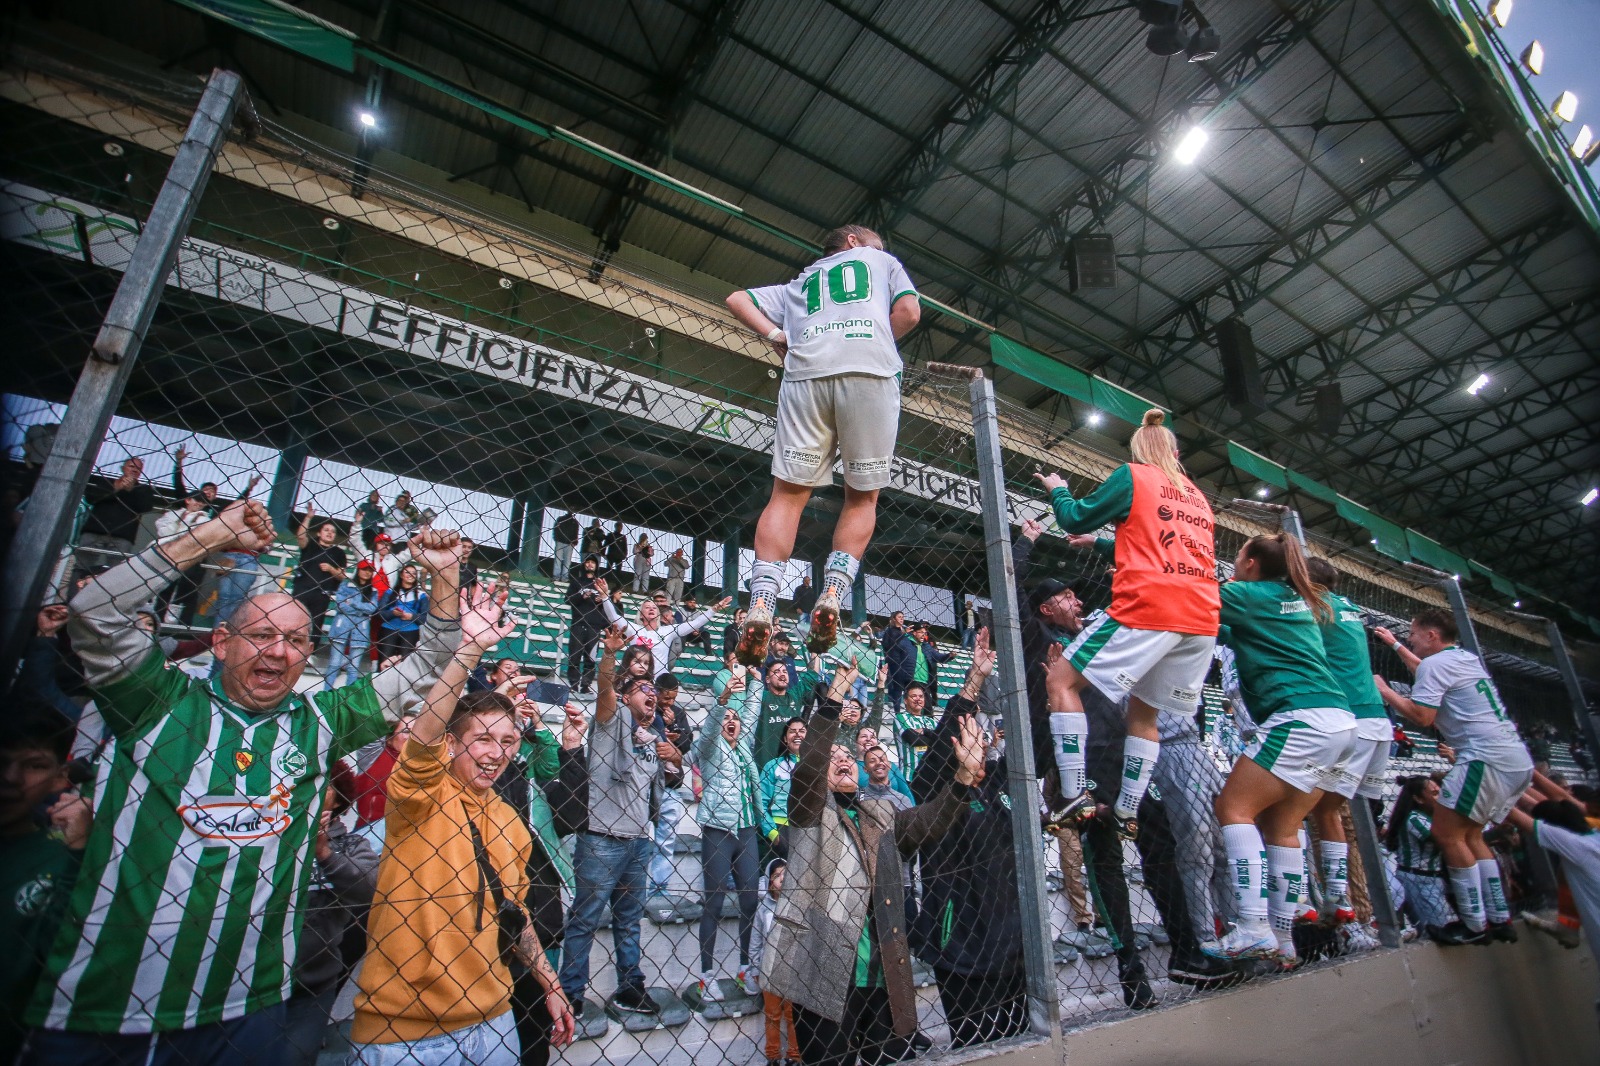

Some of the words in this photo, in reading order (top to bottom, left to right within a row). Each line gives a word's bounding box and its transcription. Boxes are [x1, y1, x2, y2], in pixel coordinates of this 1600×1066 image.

[801, 260, 872, 317] 10
[815, 318, 873, 335] humana
[367, 304, 651, 412] EFFICIENZA
[192, 812, 262, 833] Yoplait
